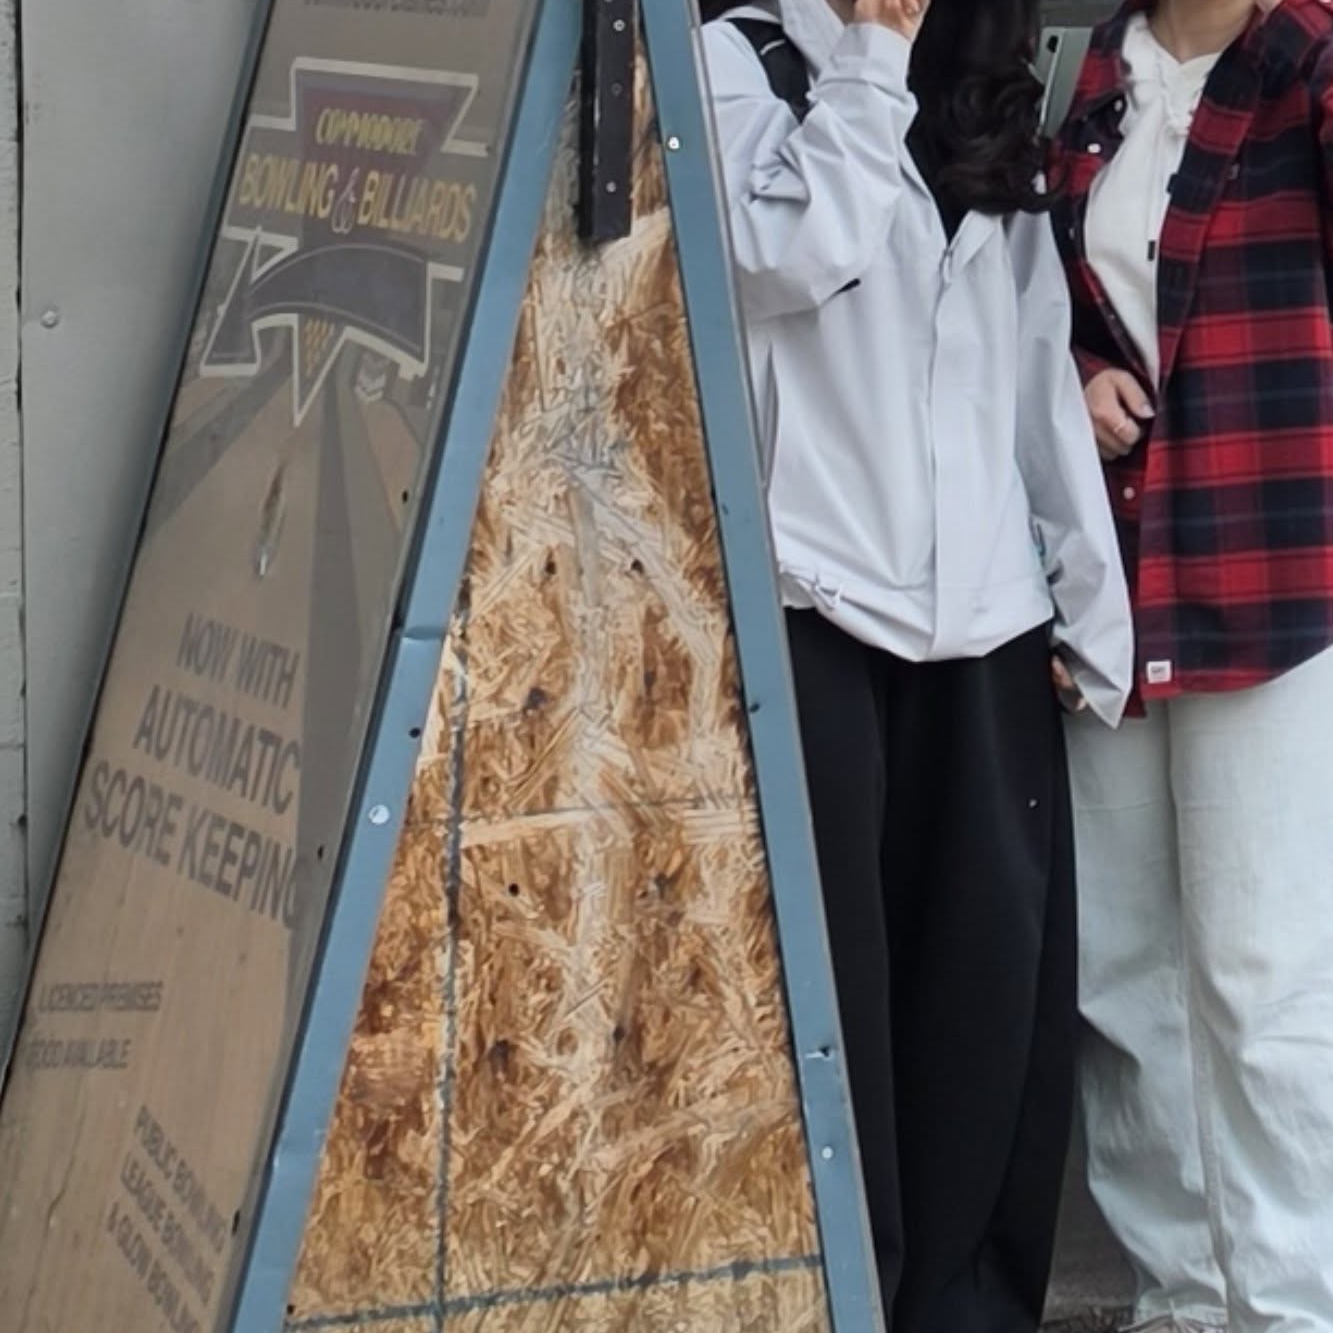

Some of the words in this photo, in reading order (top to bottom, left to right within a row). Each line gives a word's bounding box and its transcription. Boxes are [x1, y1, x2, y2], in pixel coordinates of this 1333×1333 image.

[238, 152, 338, 220] BOWLING
[356, 170, 478, 246] BILLIARDS
[174, 611, 237, 685] NOW
[233, 635, 302, 711] WITH
[132, 683, 302, 816] AUTOMATIC
[81, 760, 187, 868] SCORE
